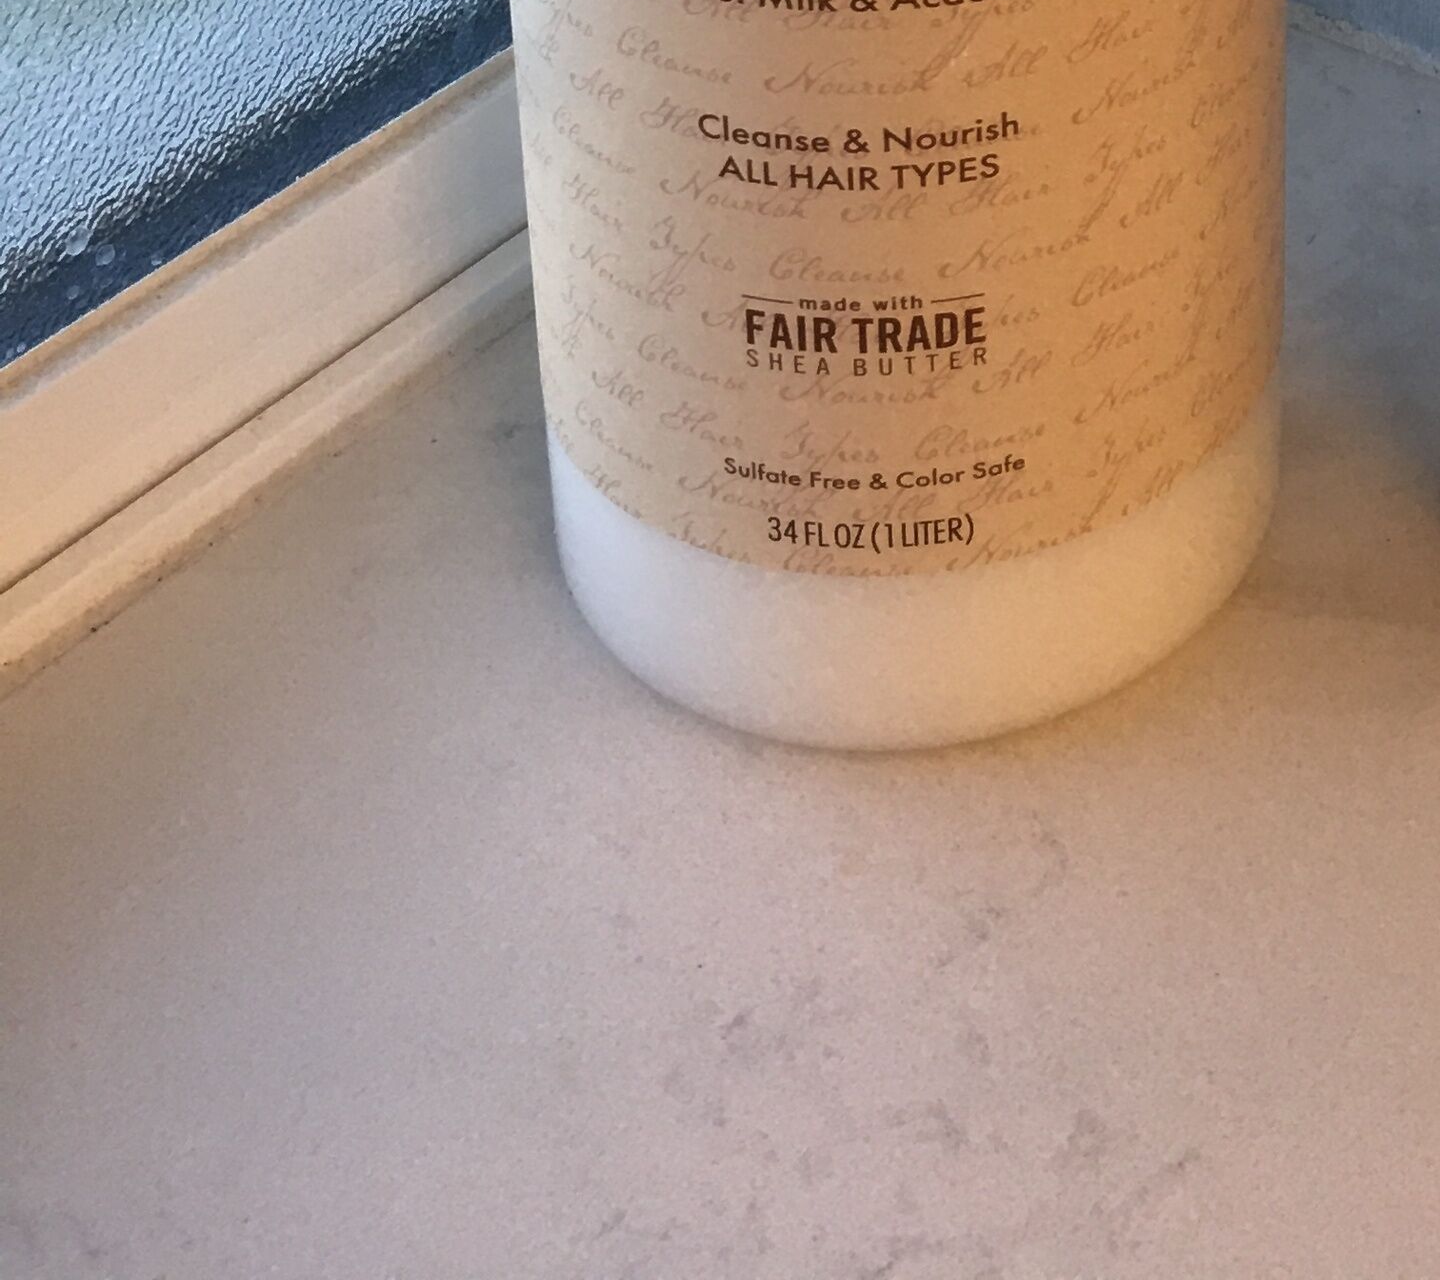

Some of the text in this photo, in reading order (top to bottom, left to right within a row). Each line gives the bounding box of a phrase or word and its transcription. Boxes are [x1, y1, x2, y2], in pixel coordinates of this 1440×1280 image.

[699, 113, 1020, 154] Cleanse & Nourish
[719, 154, 1000, 191] ALL HAIR TYPES
[799, 294, 924, 312] made with
[745, 307, 986, 354] FAIR TRADE
[746, 346, 988, 378] SHEA BUTTER
[723, 452, 1026, 490] Sulfate Free & Color Safe
